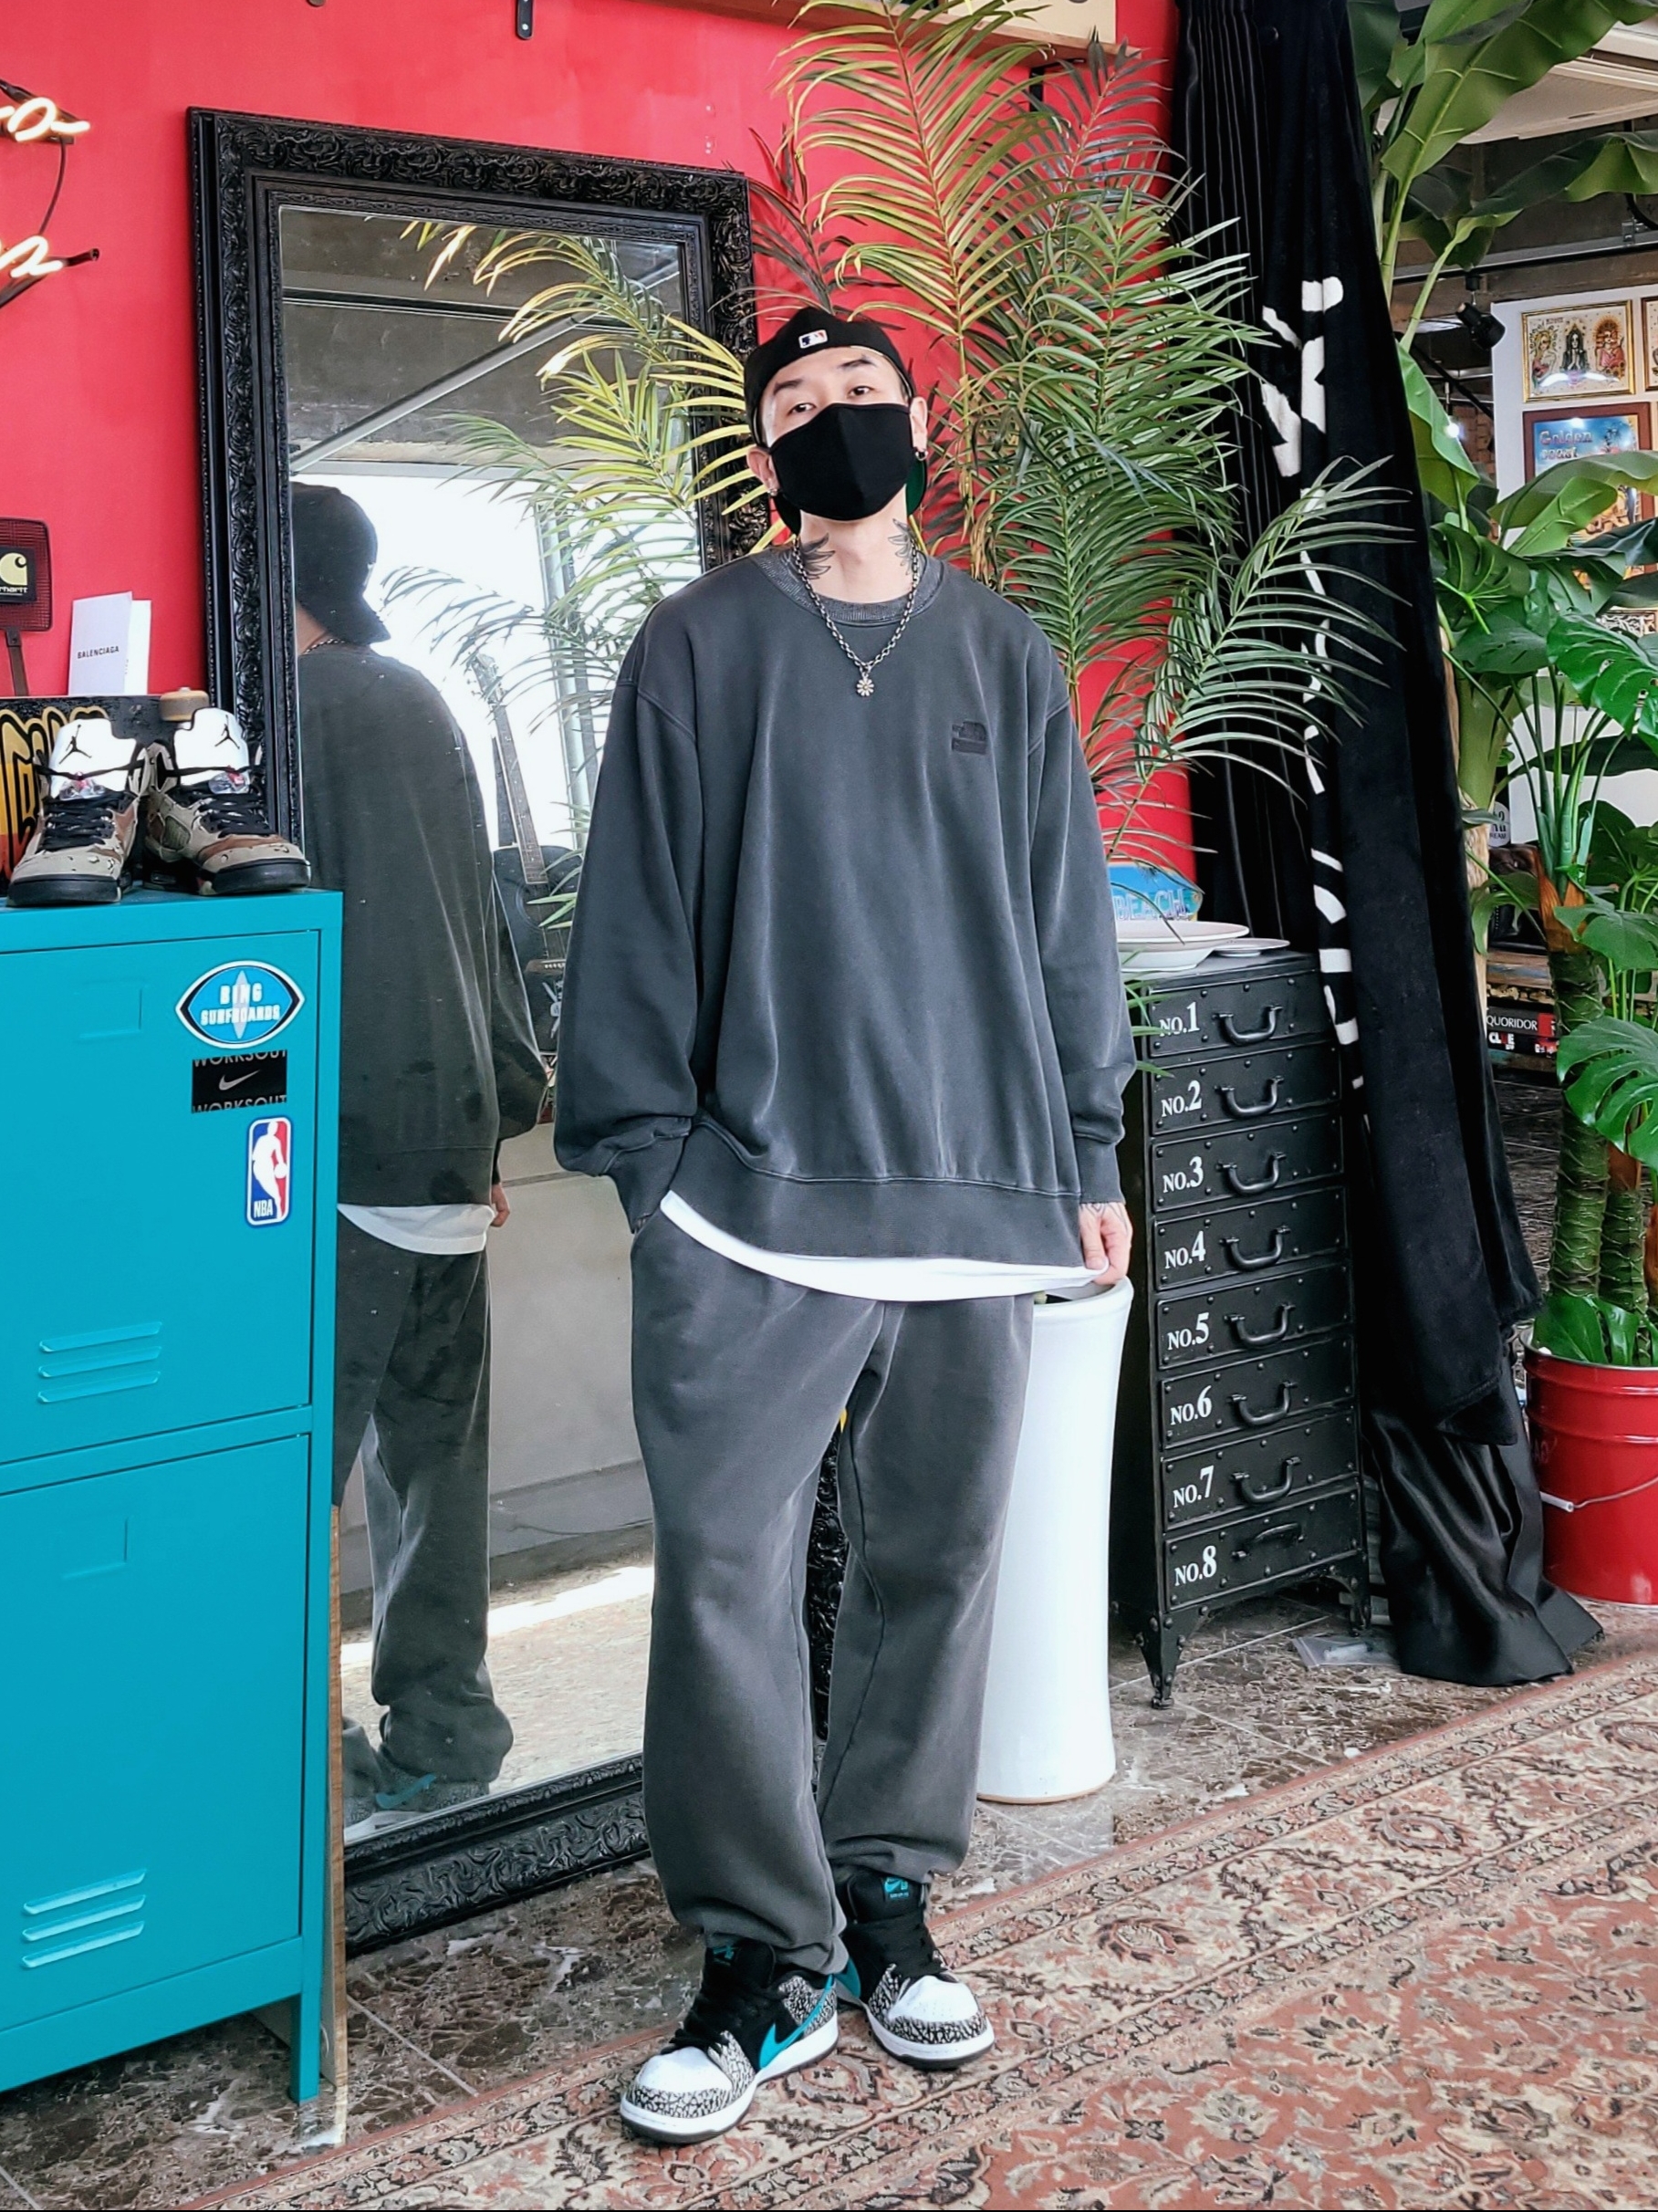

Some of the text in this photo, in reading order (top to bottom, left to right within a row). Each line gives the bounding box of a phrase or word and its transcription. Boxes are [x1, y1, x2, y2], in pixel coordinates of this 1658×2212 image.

[77, 645, 120, 659] BALENCIAGA
[200, 1005, 281, 1027] SURFBOARDS
[1159, 1001, 1200, 1038] NO.1
[1486, 1015, 1538, 1030] QUORIDOR
[1161, 1080, 1202, 1118] NO.2
[1163, 1155, 1204, 1194] NO.3
[254, 1198, 274, 1218] NBA
[1164, 1230, 1206, 1269] NO.4
[1167, 1311, 1209, 1351] NO.5
[1170, 1385, 1212, 1425] NO.6
[1173, 1465, 1215, 1508] NO.7
[1174, 1544, 1216, 1586] NO.8
